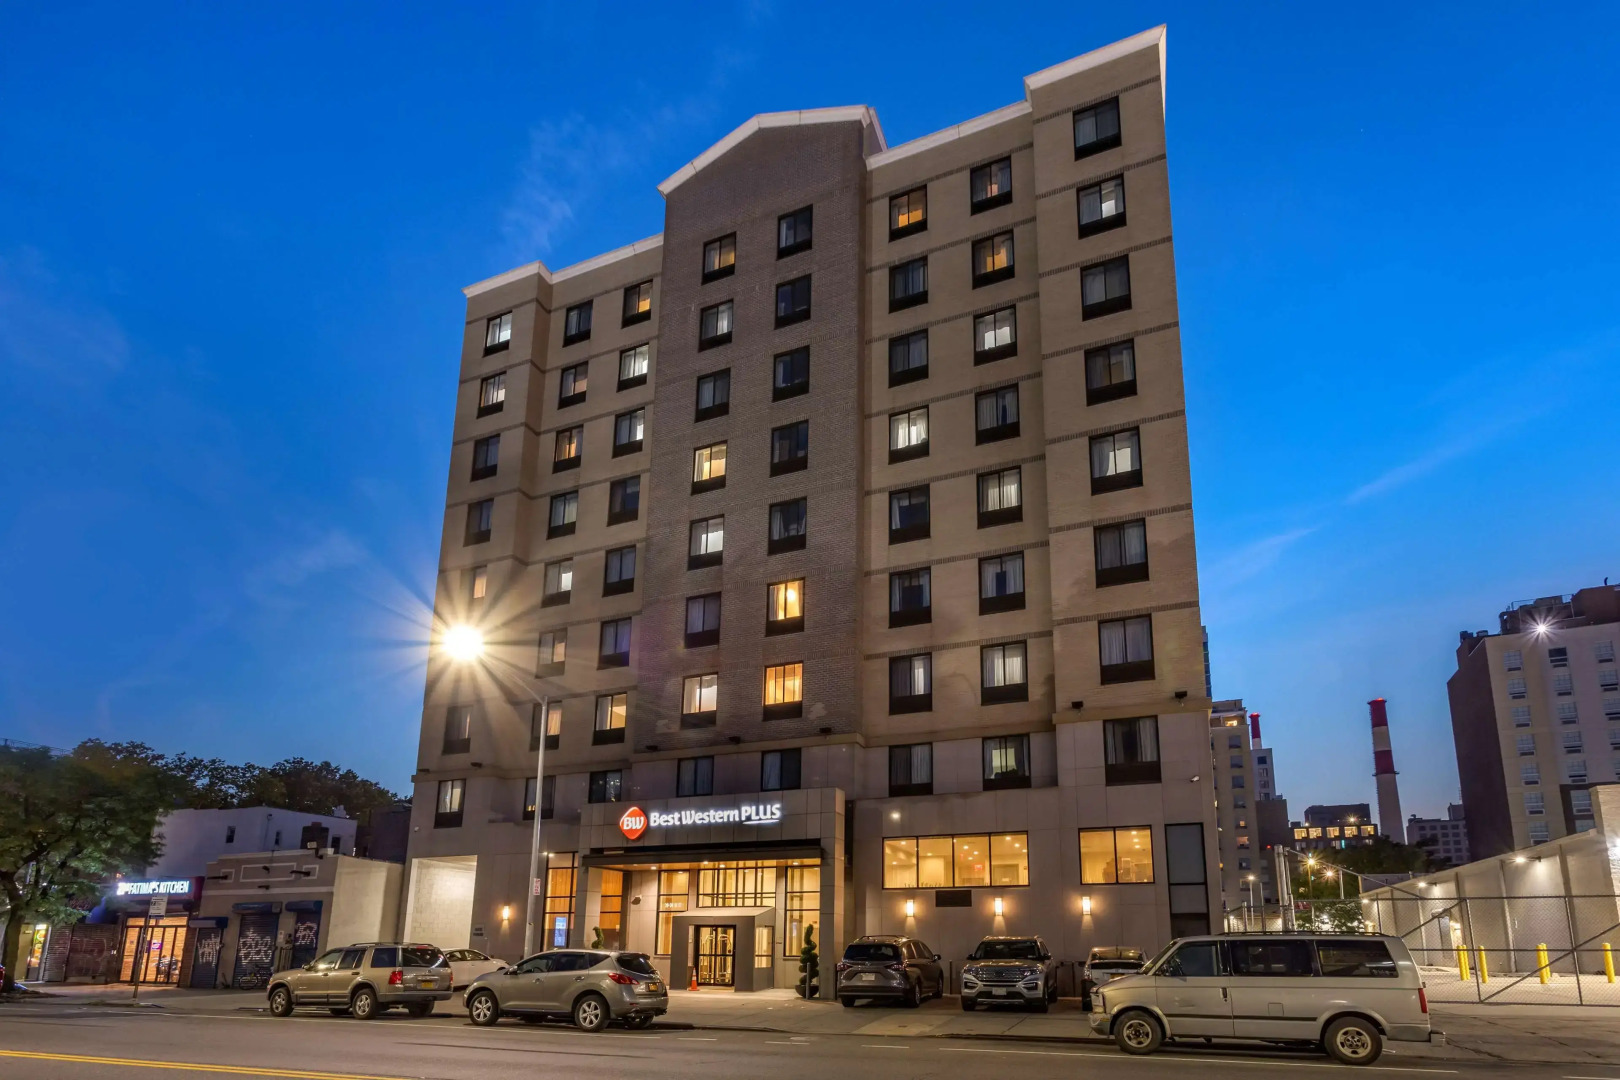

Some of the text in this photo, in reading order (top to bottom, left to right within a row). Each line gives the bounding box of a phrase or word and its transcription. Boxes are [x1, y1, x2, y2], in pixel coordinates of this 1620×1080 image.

[650, 804, 781, 827] Best Western PLUS
[623, 816, 645, 830] BW
[159, 880, 190, 894] KITCHEN
